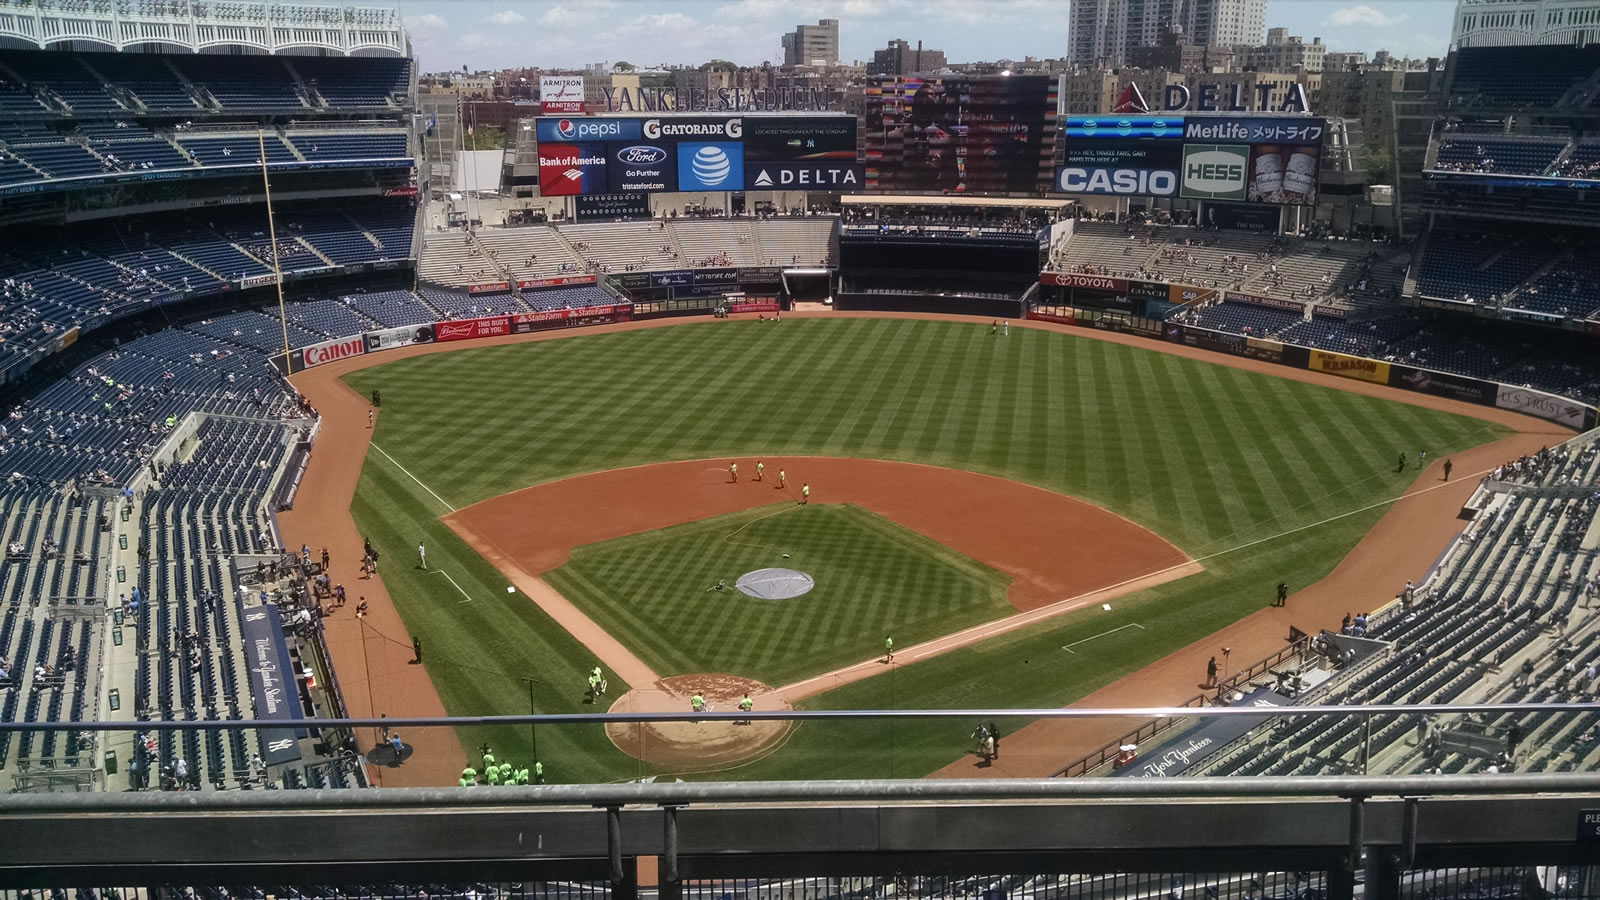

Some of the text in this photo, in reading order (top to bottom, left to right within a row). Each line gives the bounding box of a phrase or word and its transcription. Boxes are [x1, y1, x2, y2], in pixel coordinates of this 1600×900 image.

[717, 87, 830, 112] STADIUM
[1164, 83, 1310, 112] DELTA
[578, 122, 620, 138] pepsi
[662, 124, 724, 135] GATORADE
[1186, 122, 1248, 138] MetLife
[1252, 126, 1322, 140] メットライフ
[540, 156, 606, 166] Bank of America
[626, 149, 656, 162] Ford
[780, 169, 856, 184] DELTA
[1060, 168, 1176, 194] CASIO
[1188, 163, 1242, 181] HESS
[1073, 277, 1114, 288] TOYOTA
[1131, 288, 1166, 297] COACH
[305, 340, 363, 365] Canon
[1501, 392, 1561, 415] U.S. TRUST
[255, 638, 271, 660] Welcome
[253, 665, 279, 688] Yankee
[264, 688, 281, 714] Stadium
[1144, 738, 1212, 777] York Yankees
